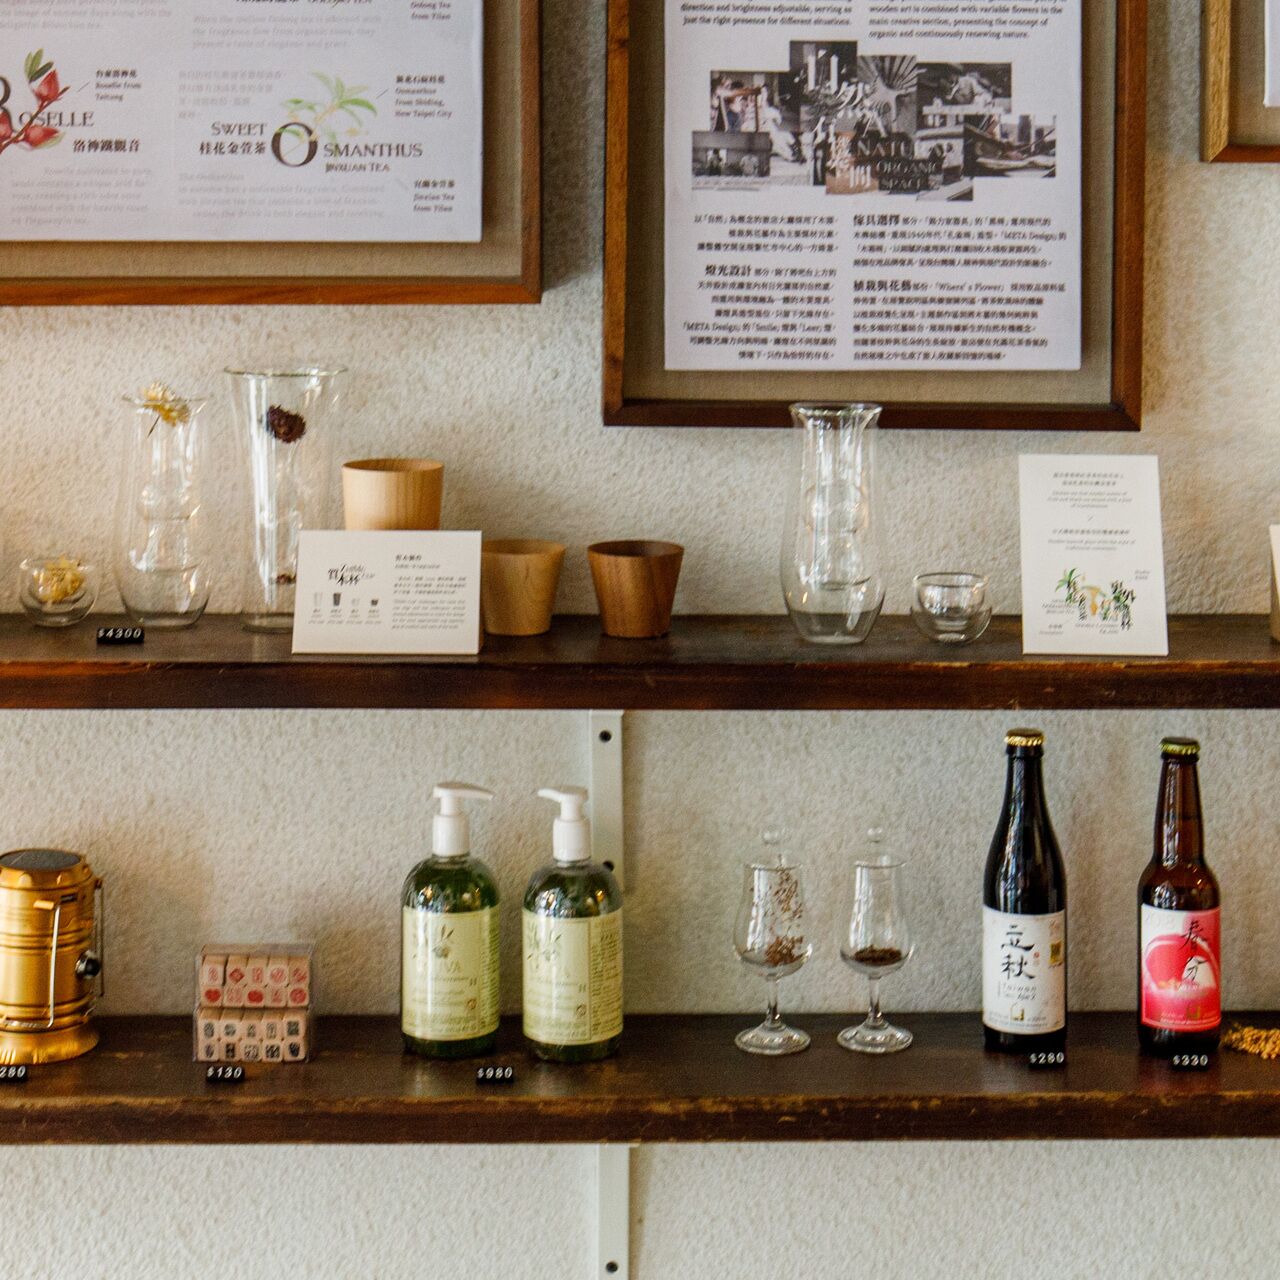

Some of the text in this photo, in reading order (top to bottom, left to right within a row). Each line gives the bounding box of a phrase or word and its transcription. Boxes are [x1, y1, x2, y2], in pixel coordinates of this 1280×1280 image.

[211, 122, 267, 136] SWEET
[271, 122, 423, 168] OSMANTHUS
[98, 628, 142, 639] $4300
[1001, 925, 1036, 980] 立秋
